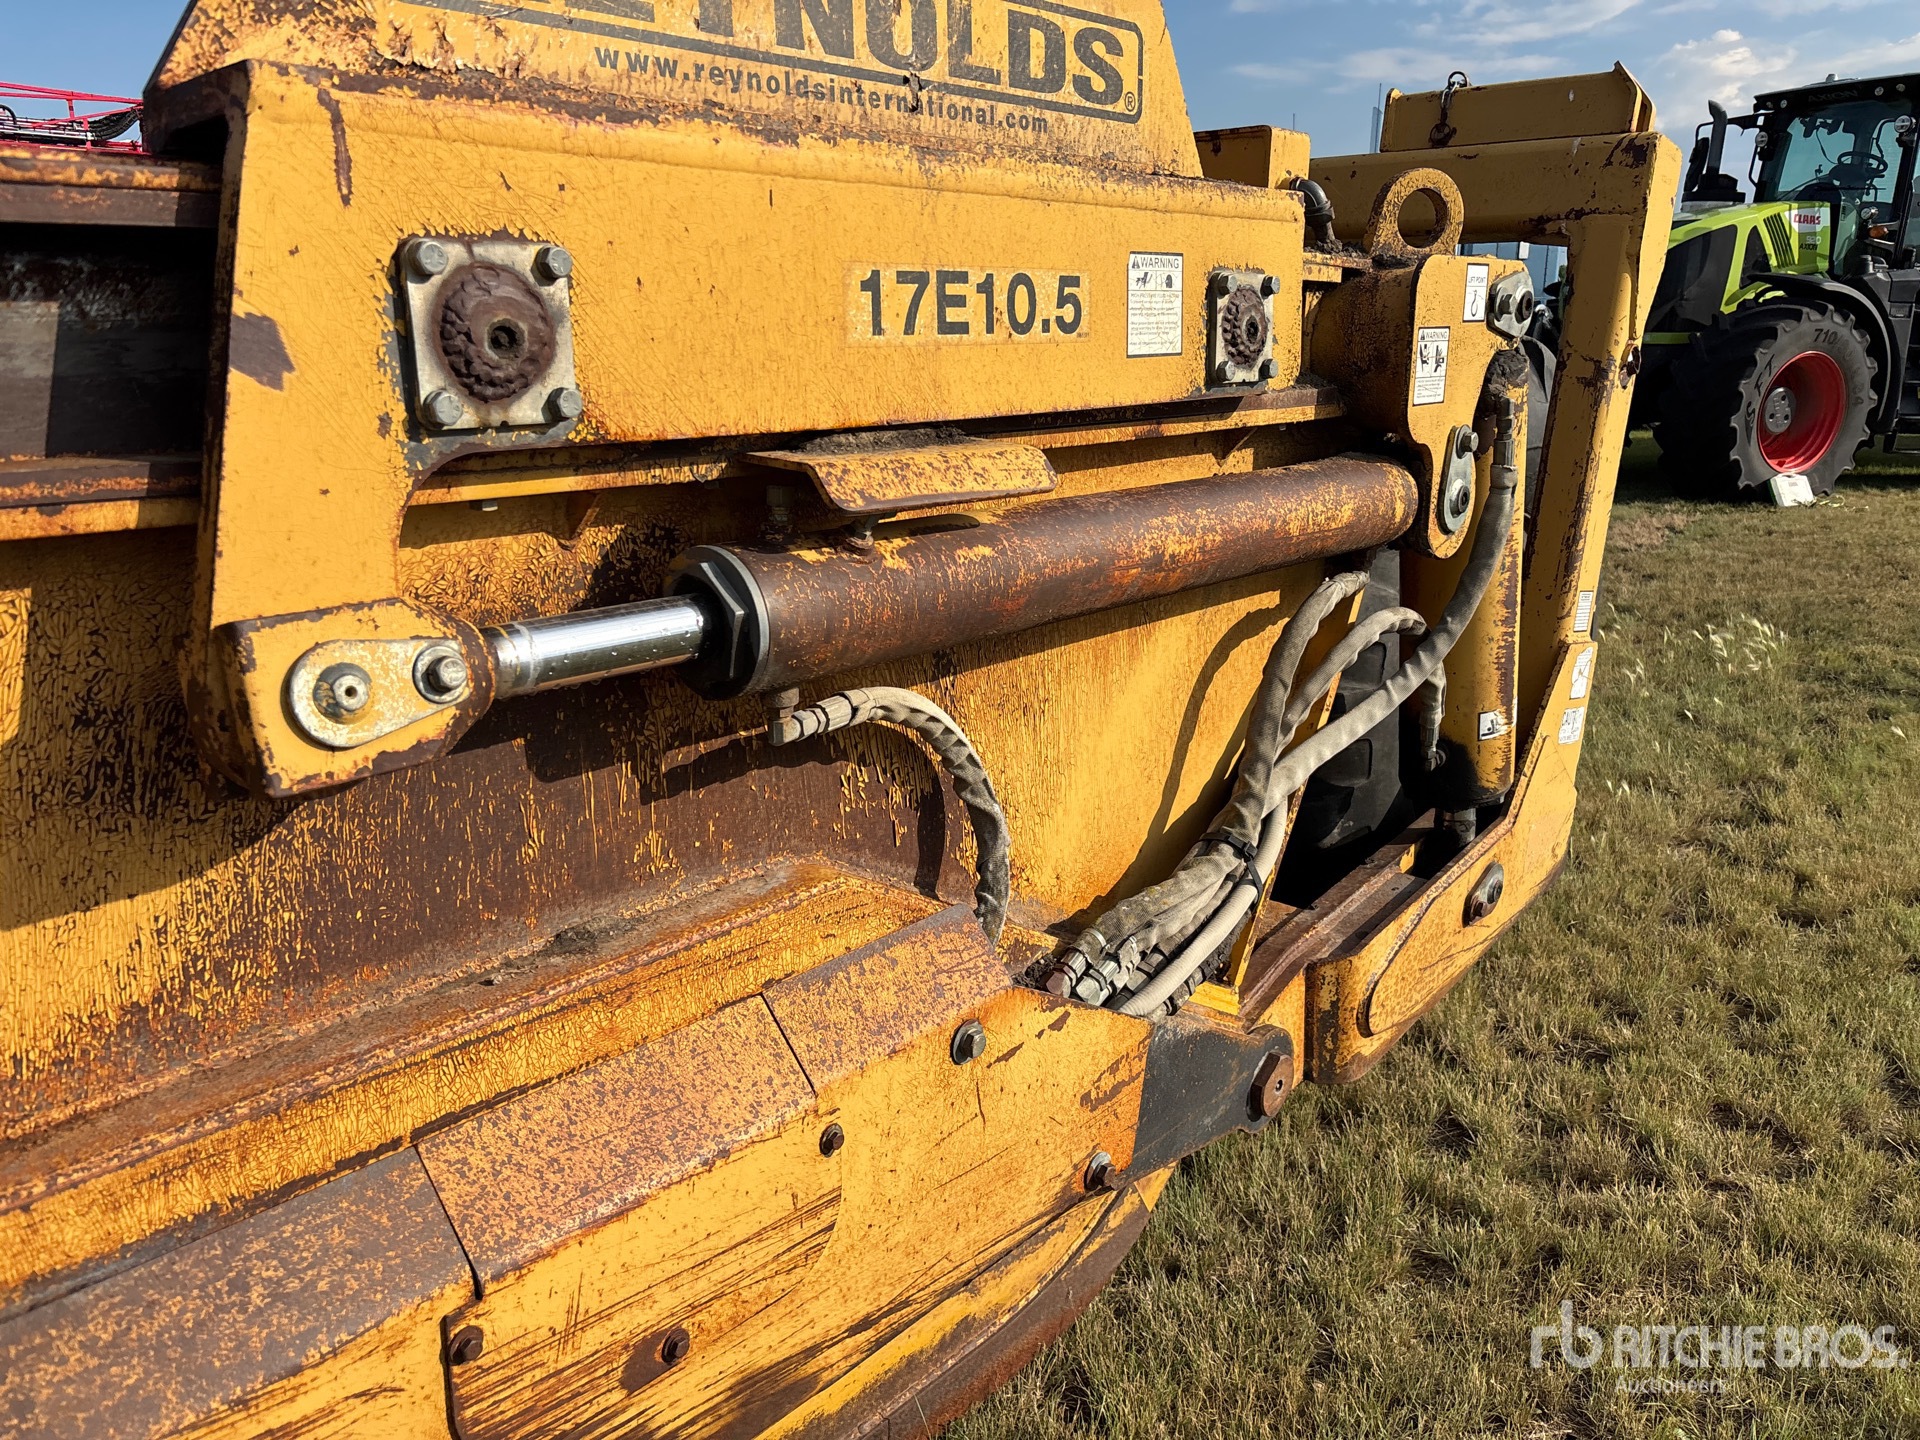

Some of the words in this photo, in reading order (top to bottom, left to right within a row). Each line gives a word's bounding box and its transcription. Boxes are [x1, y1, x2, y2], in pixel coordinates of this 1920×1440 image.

[1793, 213, 1821, 225] CLAAS
[1140, 256, 1180, 269] WARNING
[860, 269, 1082, 336] 17E10.5
[1425, 330, 1448, 340] WARNING
